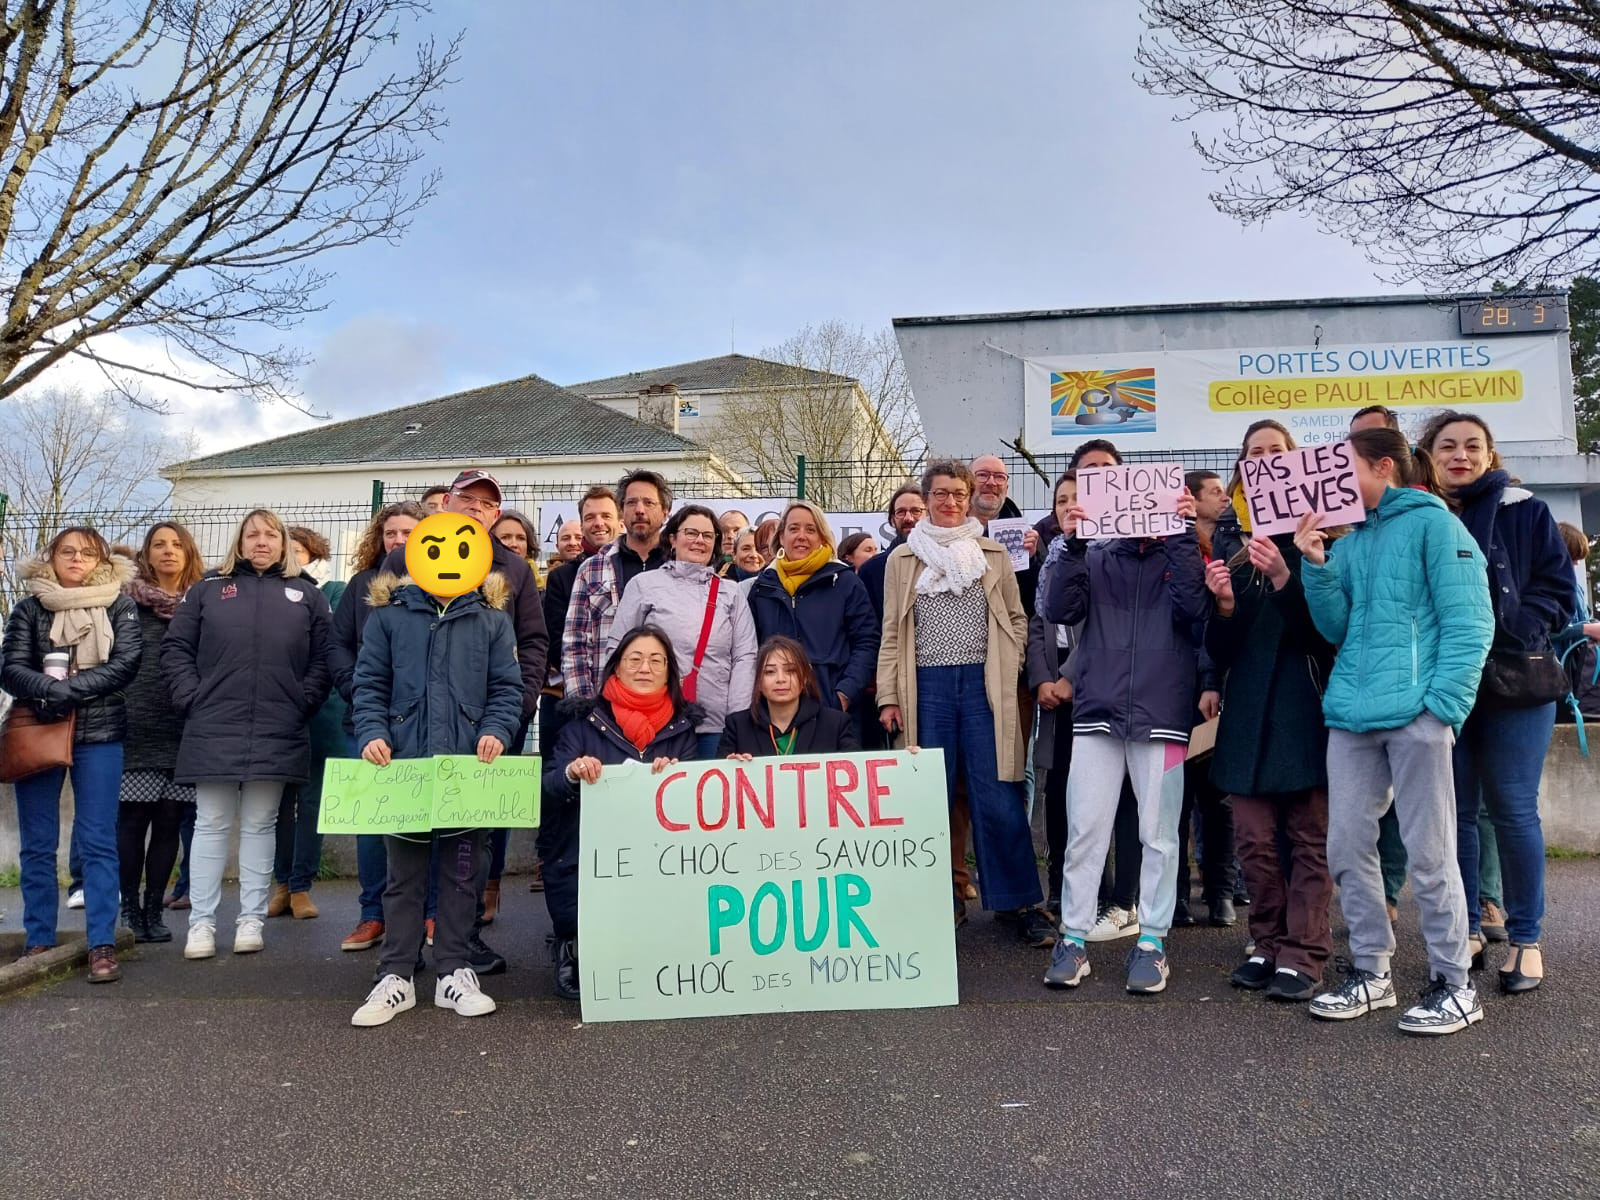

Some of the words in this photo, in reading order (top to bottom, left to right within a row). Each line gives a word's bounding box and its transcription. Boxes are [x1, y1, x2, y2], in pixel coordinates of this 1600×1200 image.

[1239, 350, 1340, 375] PORTES
[1348, 345, 1491, 372] OUVERTES
[1215, 384, 1308, 410] Collège
[1315, 380, 1380, 403] PAUL
[1386, 375, 1517, 400] LANGEVIN
[1291, 415, 1344, 427] SAMEDI
[1303, 431, 1320, 443] de
[1244, 455, 1291, 487] PAS
[1301, 443, 1350, 476] LES
[1115, 492, 1158, 512] LES
[1250, 471, 1359, 526] ÉLÈVES
[1080, 510, 1183, 537] DÉCHETS
[331, 760, 360, 785] Au
[438, 758, 466, 781] On
[473, 760, 537, 789] apprend
[655, 757, 904, 832] CONTRE
[324, 794, 361, 826] Paul
[367, 794, 430, 830] Langevin
[594, 847, 633, 878] LE
[757, 850, 802, 872] DES
[708, 873, 880, 956] POUR
[592, 967, 636, 1002] LE
[656, 960, 735, 997] CHOC
[752, 973, 792, 992] DES
[810, 951, 921, 985] MOYENS
